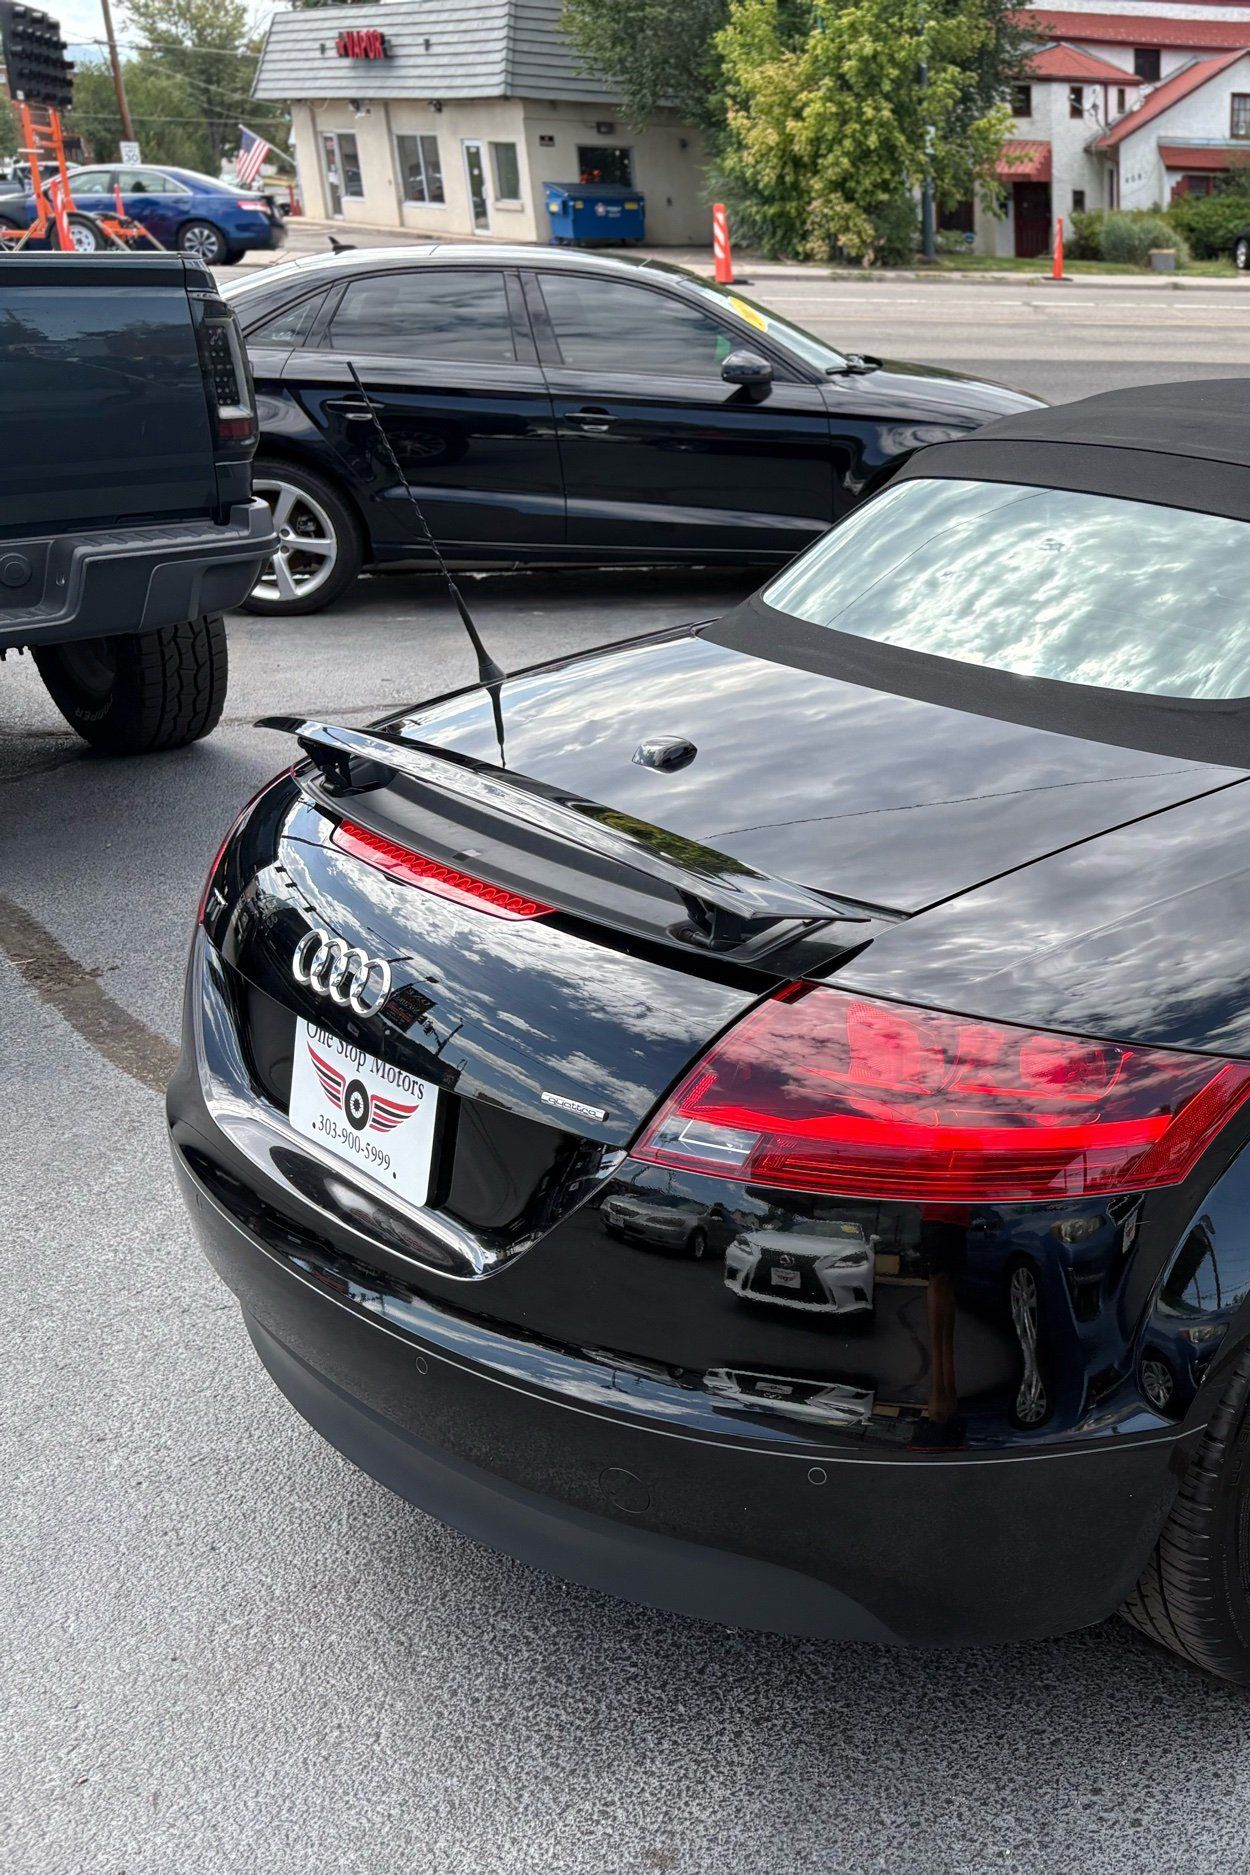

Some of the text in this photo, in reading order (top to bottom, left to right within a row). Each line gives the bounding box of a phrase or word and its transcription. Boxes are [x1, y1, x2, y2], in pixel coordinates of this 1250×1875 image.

[345, 30, 383, 60] VAPOR
[306, 1021, 425, 1100] One Stop Motors
[547, 1096, 597, 1118] quattro
[318, 1114, 391, 1171] 303-900-5999
